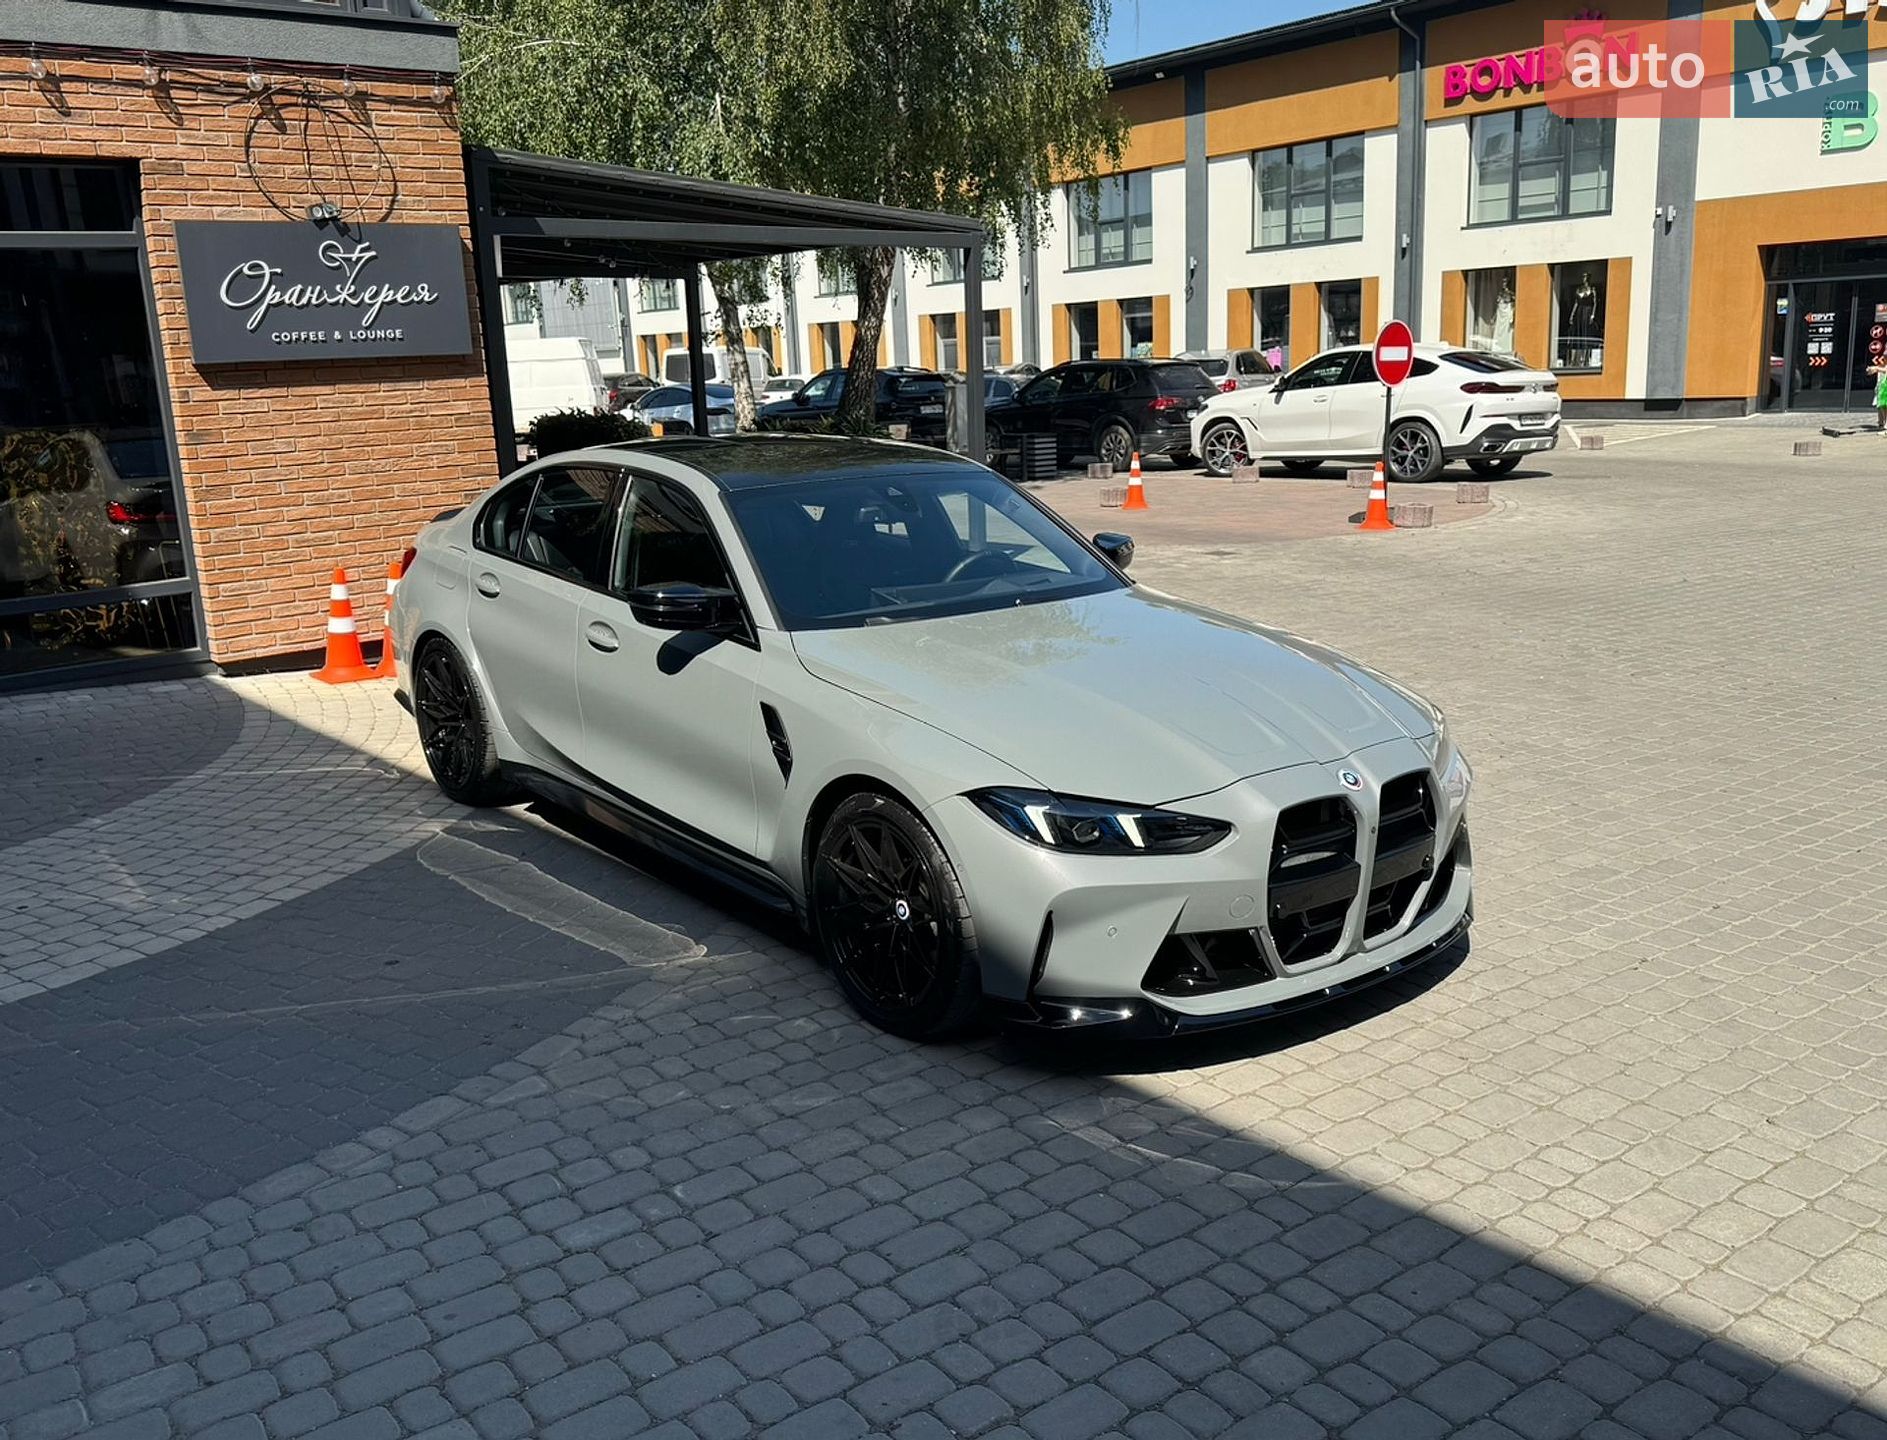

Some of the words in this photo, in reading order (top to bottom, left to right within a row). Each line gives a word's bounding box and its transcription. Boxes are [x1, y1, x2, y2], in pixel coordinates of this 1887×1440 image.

[1444, 31, 1640, 99] BONBON
[219, 258, 439, 329] Оранжерея
[271, 330, 326, 342] COFFEE
[333, 330, 342, 340] &
[349, 328, 404, 340] LOUNGE
